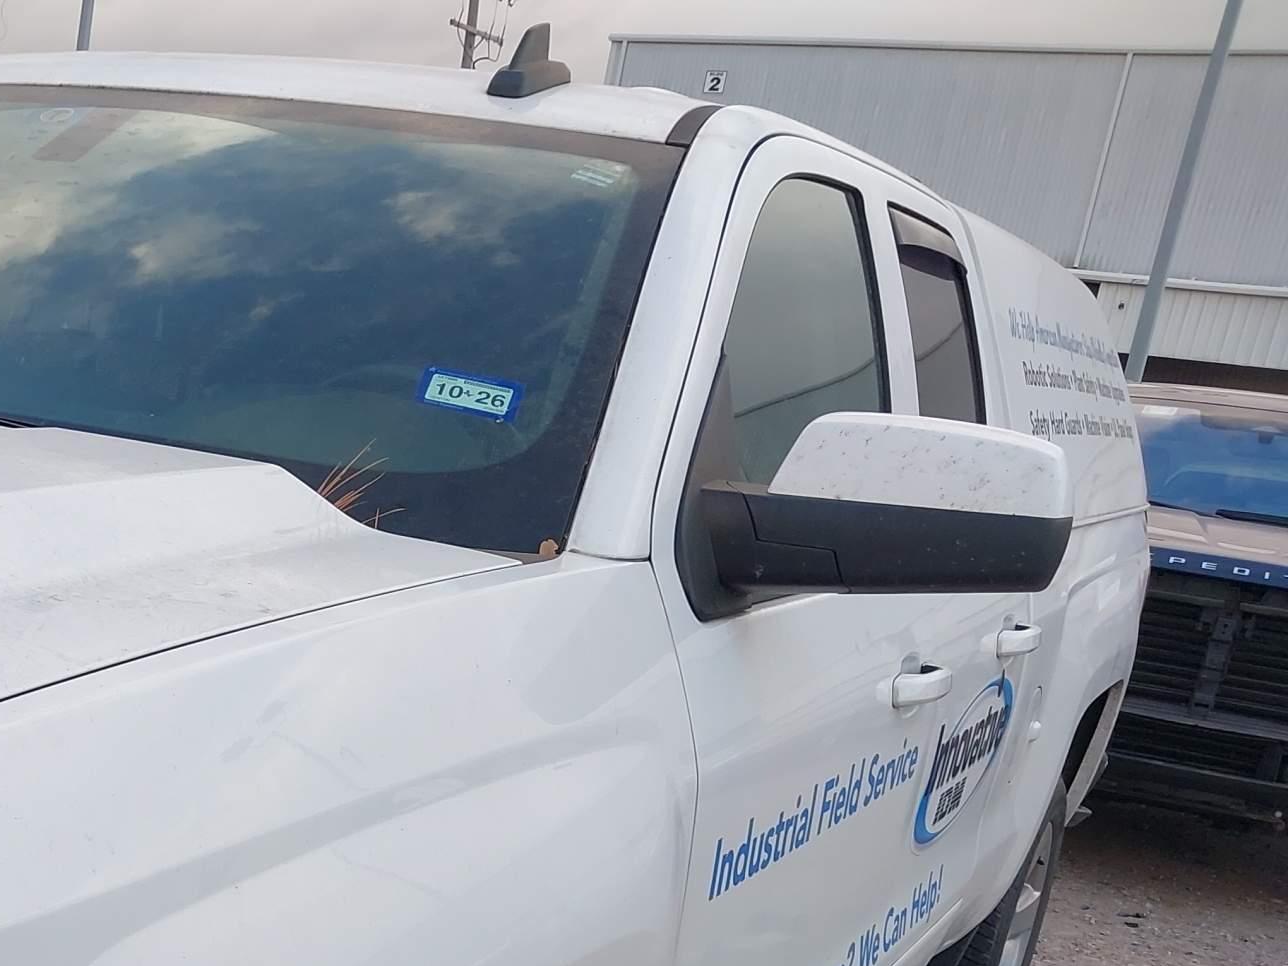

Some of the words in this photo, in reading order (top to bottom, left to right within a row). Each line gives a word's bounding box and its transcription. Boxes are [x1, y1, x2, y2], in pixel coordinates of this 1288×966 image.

[708, 77, 721, 91] 2
[1022, 360, 1048, 387] Robotic
[436, 382, 464, 399] 10
[474, 391, 506, 408] 26
[1029, 408, 1051, 441] Safety
[1150, 551, 1288, 580] PEDI
[925, 704, 1008, 795] Innovative
[709, 783, 819, 901] Industrial
[817, 757, 866, 835] Field
[864, 737, 919, 807] Service
[883, 906, 908, 953] Can
[910, 863, 944, 929] Help!
